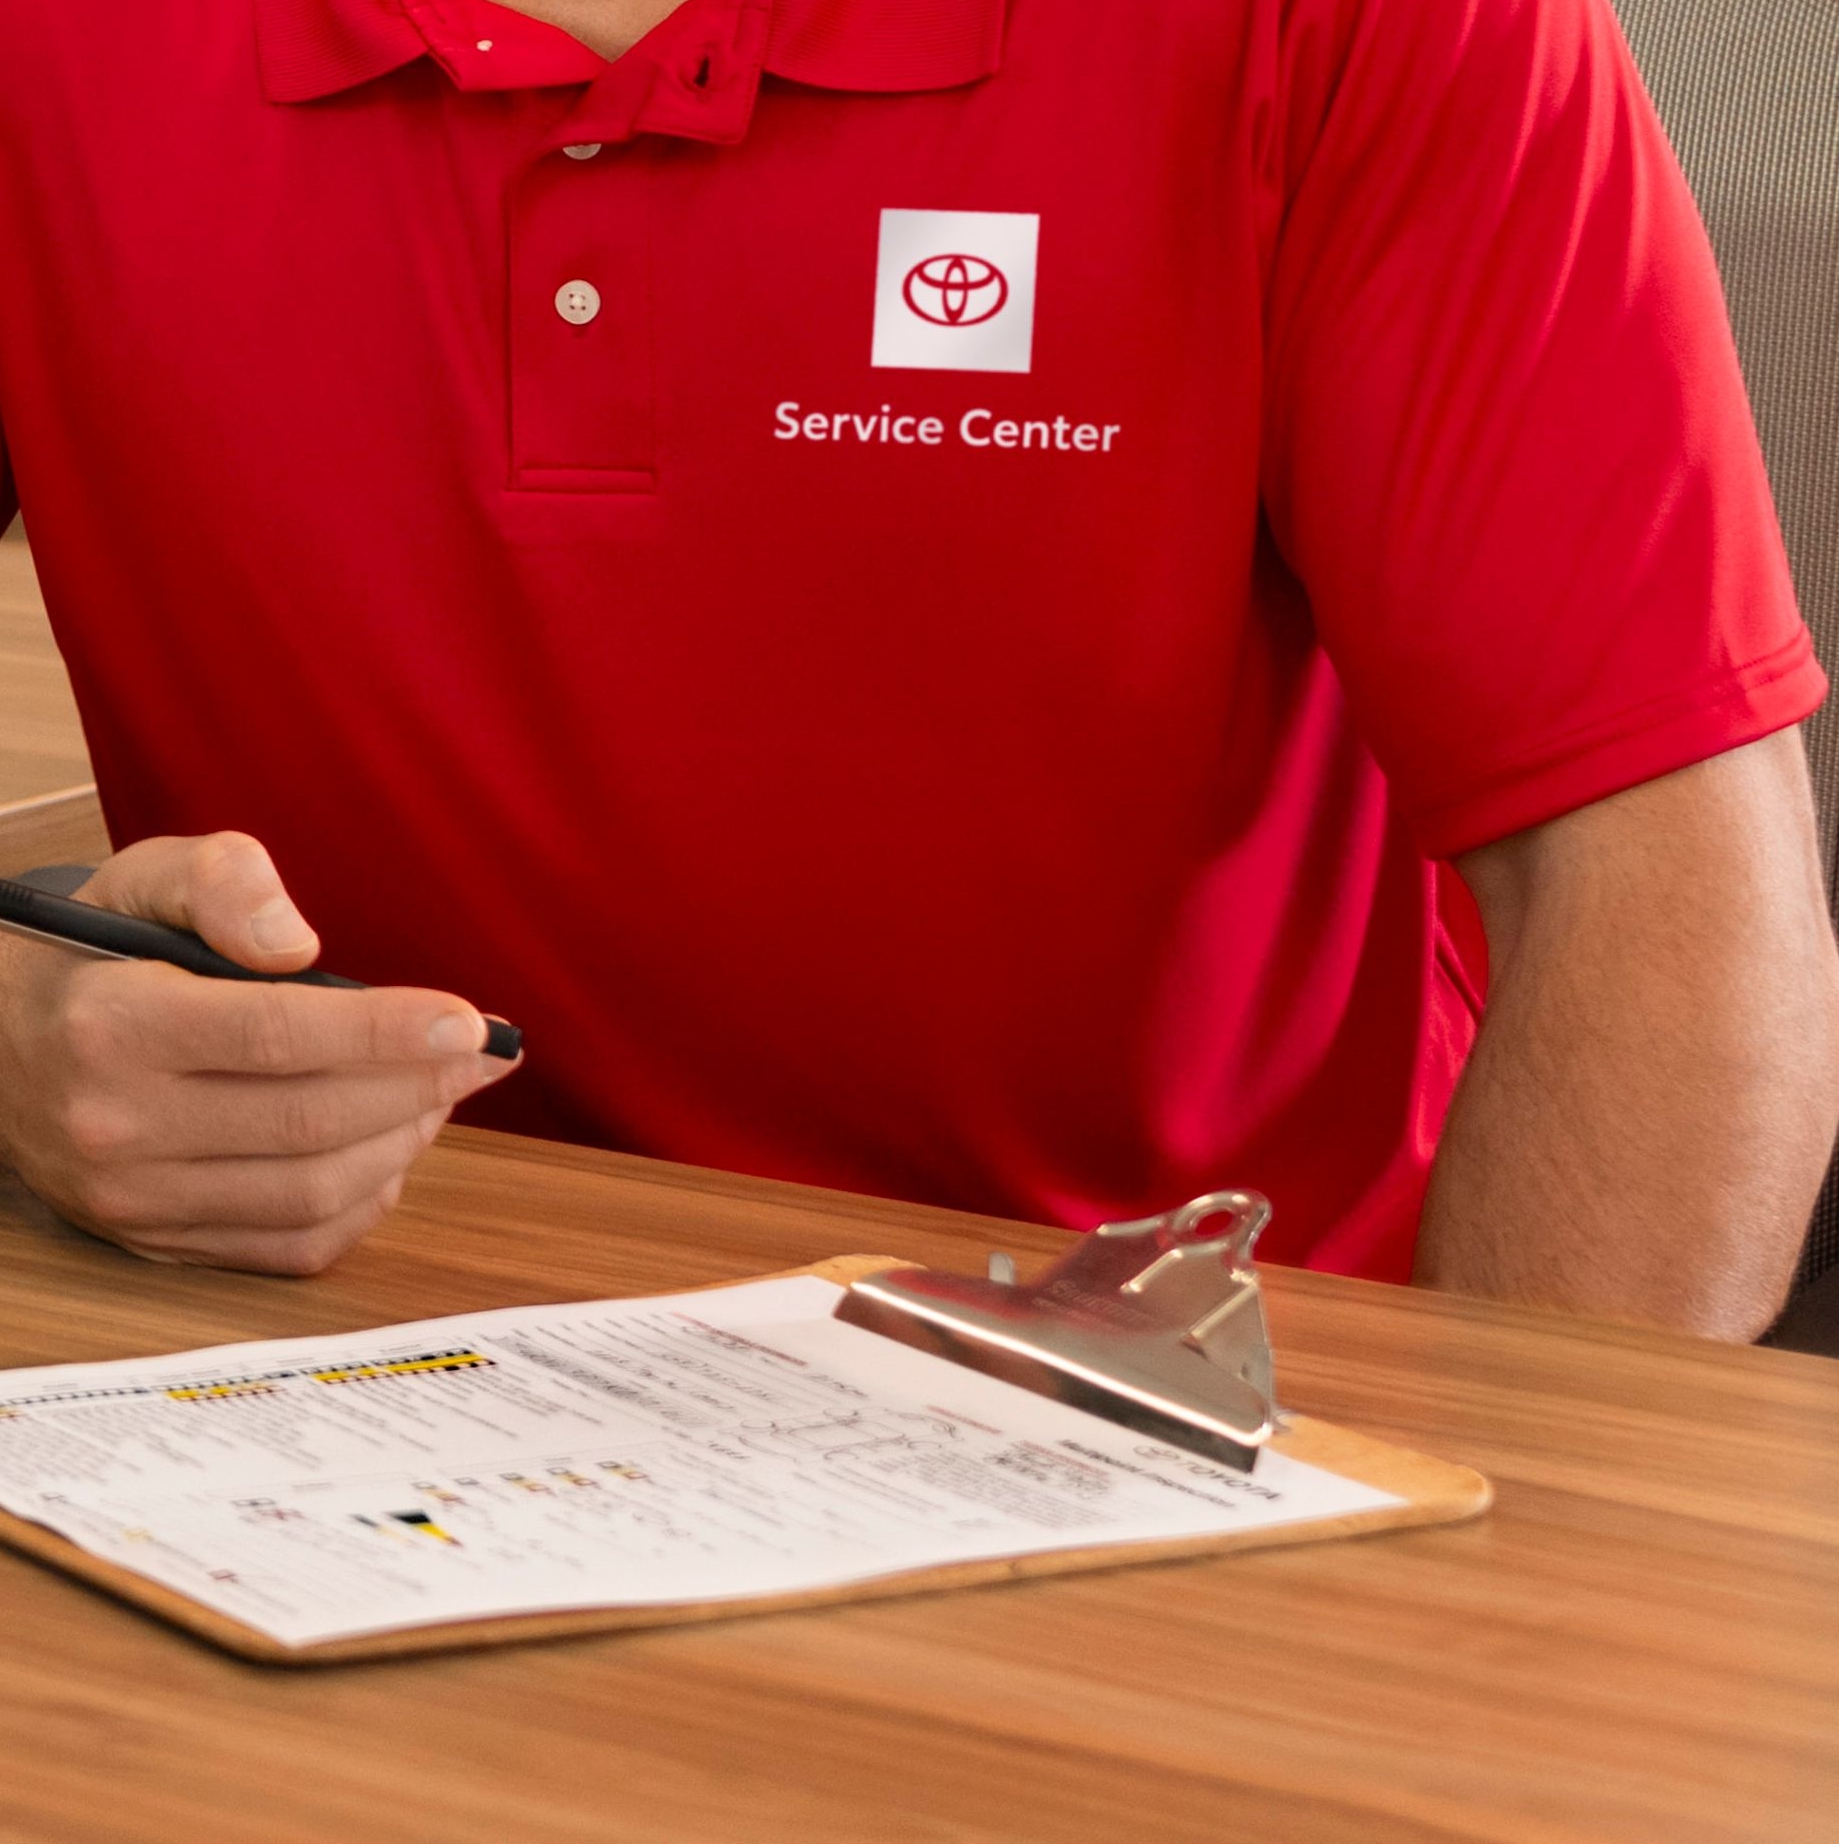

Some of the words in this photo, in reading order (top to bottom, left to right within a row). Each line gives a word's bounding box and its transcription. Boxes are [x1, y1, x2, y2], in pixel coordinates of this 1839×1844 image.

[774, 401, 944, 445] Service
[959, 408, 1121, 452] Center
[1177, 1460, 1281, 1500] TOYOTA
